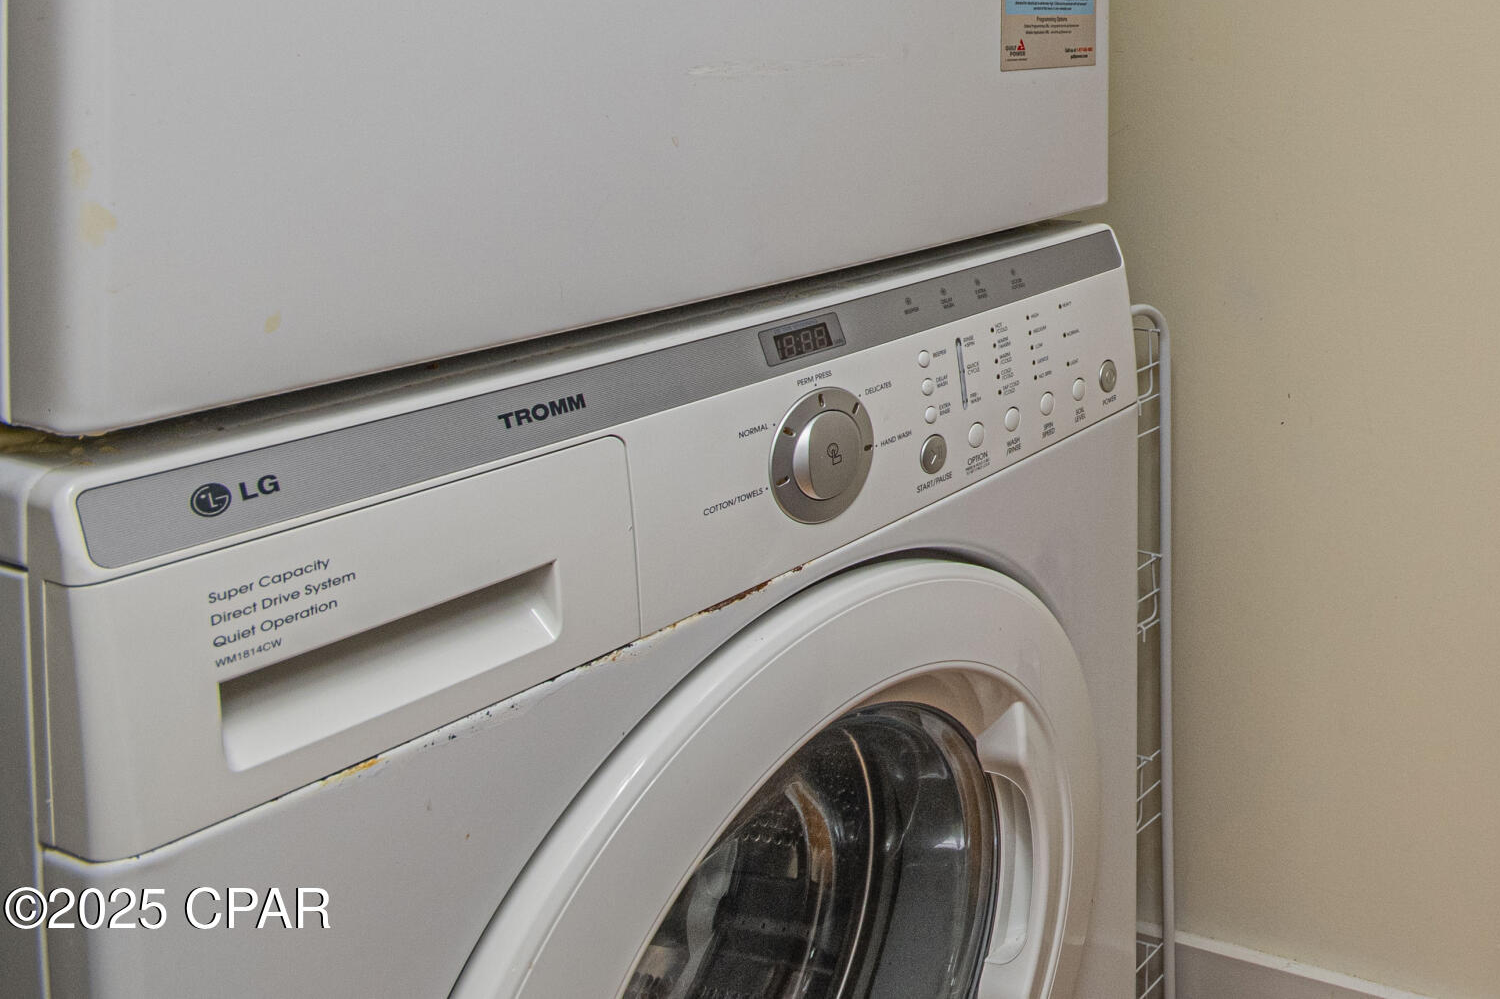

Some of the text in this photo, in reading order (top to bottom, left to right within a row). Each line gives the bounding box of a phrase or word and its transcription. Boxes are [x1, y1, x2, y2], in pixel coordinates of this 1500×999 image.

[796, 370, 832, 387] PERM PRESS
[864, 381, 892, 396] DELICATES
[497, 393, 587, 429] TROMM
[1102, 394, 1117, 406] POWER
[738, 423, 768, 439] NORMAL
[880, 430, 912, 448] HAND WASH
[1006, 436, 1020, 448] WASH
[967, 450, 988, 466] OPTION
[239, 474, 280, 501] LG
[916, 471, 953, 494] START/PAUSE
[703, 487, 764, 516] COTTON/TOWELS
[208, 558, 330, 603] Super Capacity
[210, 572, 356, 626] Direct Drive System
[212, 600, 338, 648] Quiet Operation
[215, 638, 282, 668] WM1814CW
